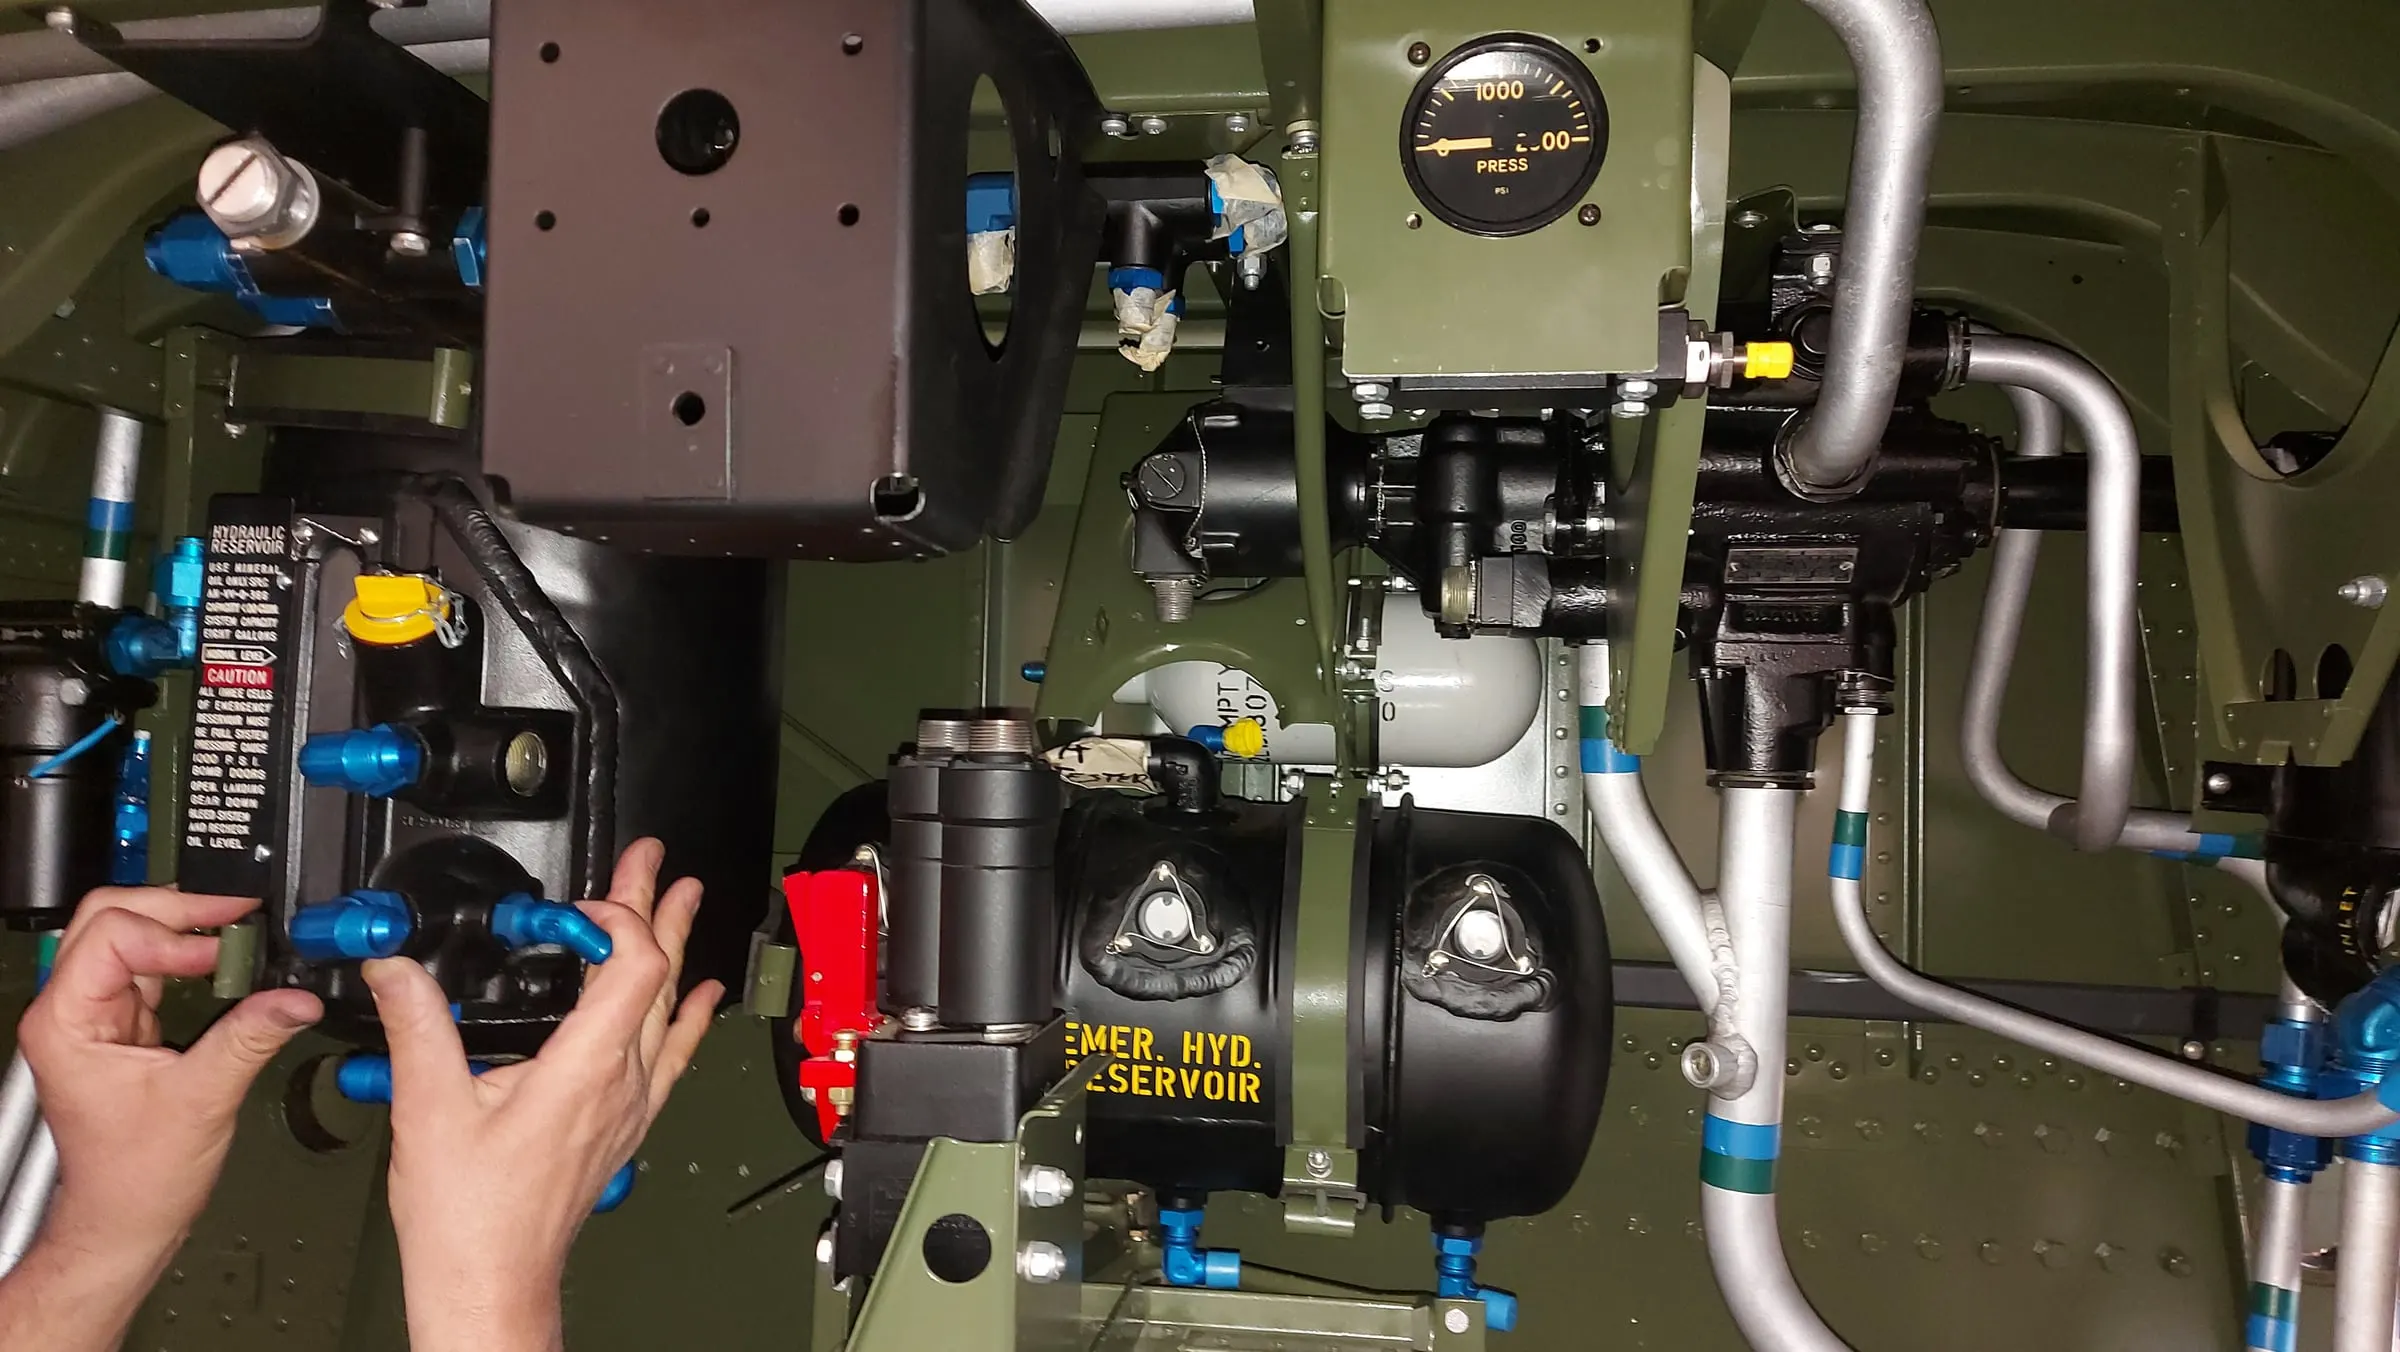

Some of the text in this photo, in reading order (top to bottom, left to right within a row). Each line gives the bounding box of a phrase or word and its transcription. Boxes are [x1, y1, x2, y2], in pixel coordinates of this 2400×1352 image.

[1477, 80, 1524, 101] 1000
[1476, 157, 1529, 174] PRESS
[1494, 186, 1510, 196] PSI
[212, 524, 286, 540] HYDRAULIC
[210, 539, 285, 555] RESERVOIR
[208, 562, 231, 573] USE
[234, 629, 279, 642] GALLONS
[207, 668, 268, 685] CAUTION
[192, 753, 220, 765] 1000
[228, 767, 268, 780] DOORS
[224, 795, 259, 809] DOWN
[1065, 1021, 1165, 1062] EMER.
[1182, 1030, 1263, 1069] HYD.
[1065, 1059, 1261, 1104] ESERVOIR
